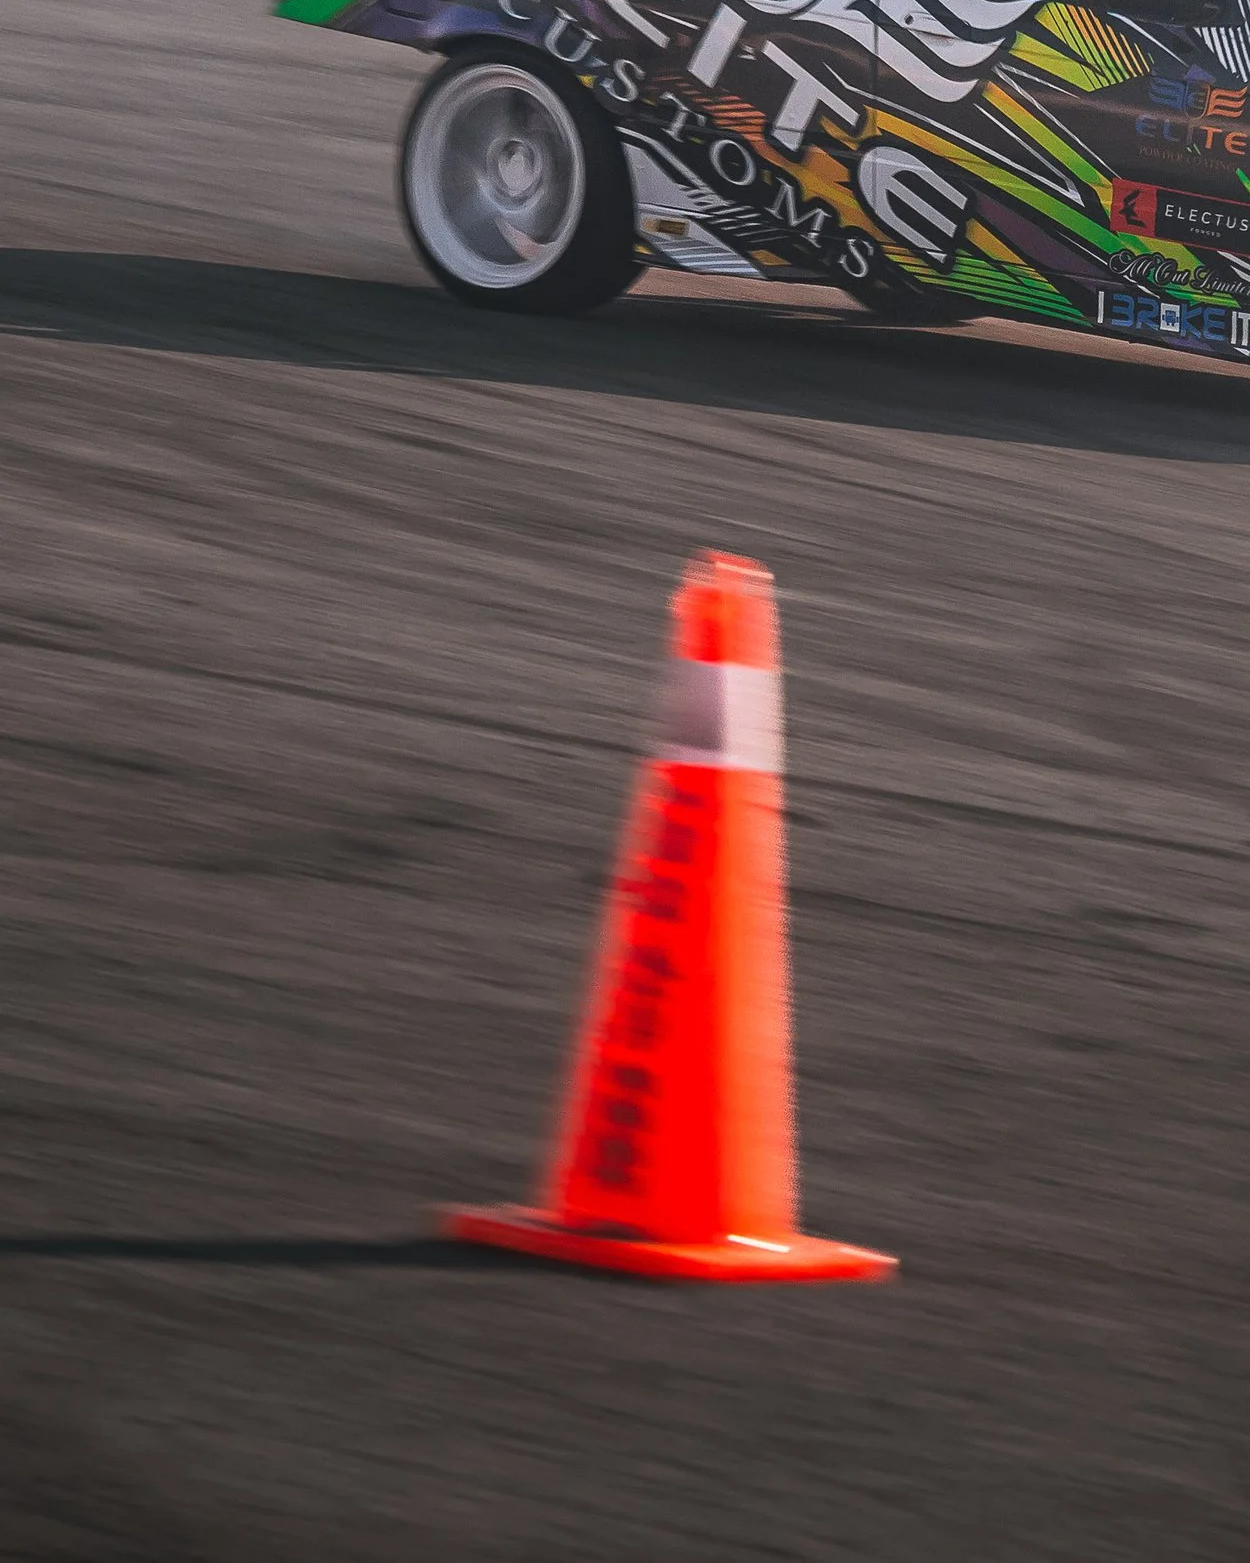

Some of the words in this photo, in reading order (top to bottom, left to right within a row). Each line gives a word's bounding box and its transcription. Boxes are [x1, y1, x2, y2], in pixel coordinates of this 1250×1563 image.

[1135, 114, 1249, 156] ELITE
[1165, 204, 1249, 232] ELECTUS
[1109, 251, 1151, 278] All
[1097, 291, 1105, 324] I
